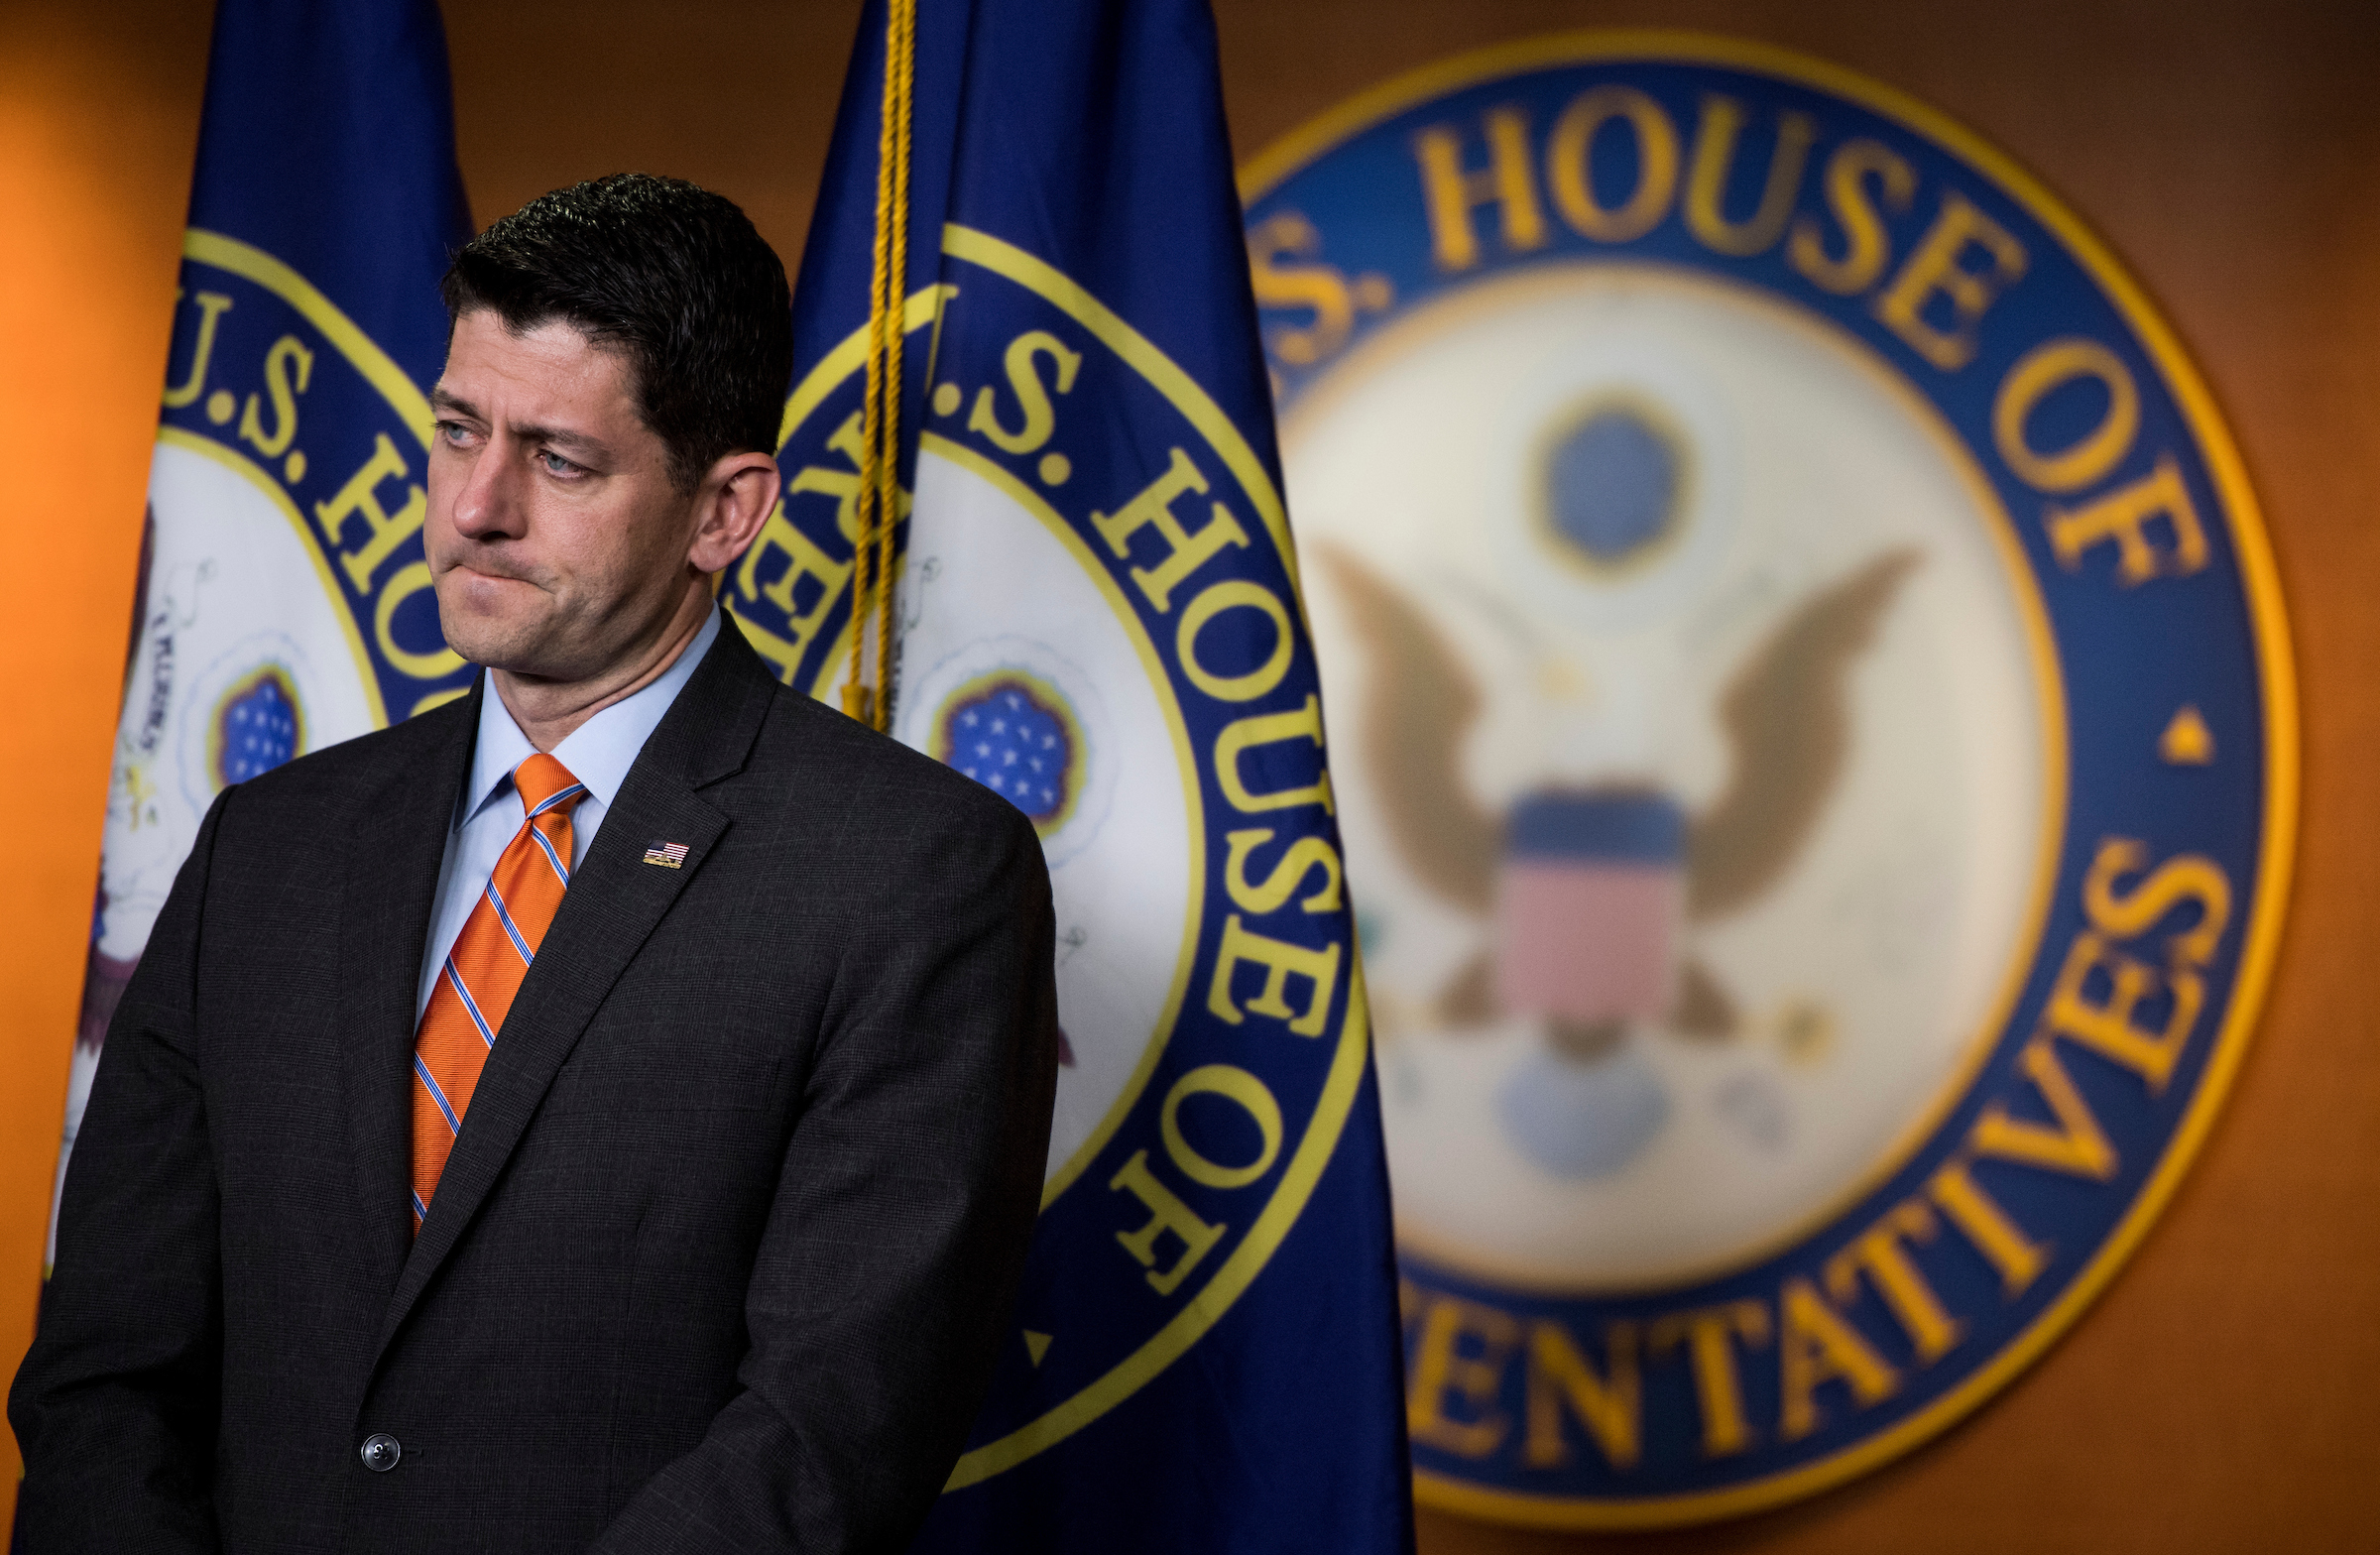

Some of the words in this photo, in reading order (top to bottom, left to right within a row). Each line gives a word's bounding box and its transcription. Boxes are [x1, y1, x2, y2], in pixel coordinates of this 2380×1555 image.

[315, 432, 471, 718] HO
[1415, 84, 2028, 370] HOUSE
[1992, 338, 2212, 586] OF
[1090, 446, 1344, 1038] HOUSE
[1109, 1063, 1283, 1296] OF
[1402, 835, 2236, 1470] ENTATIVES
